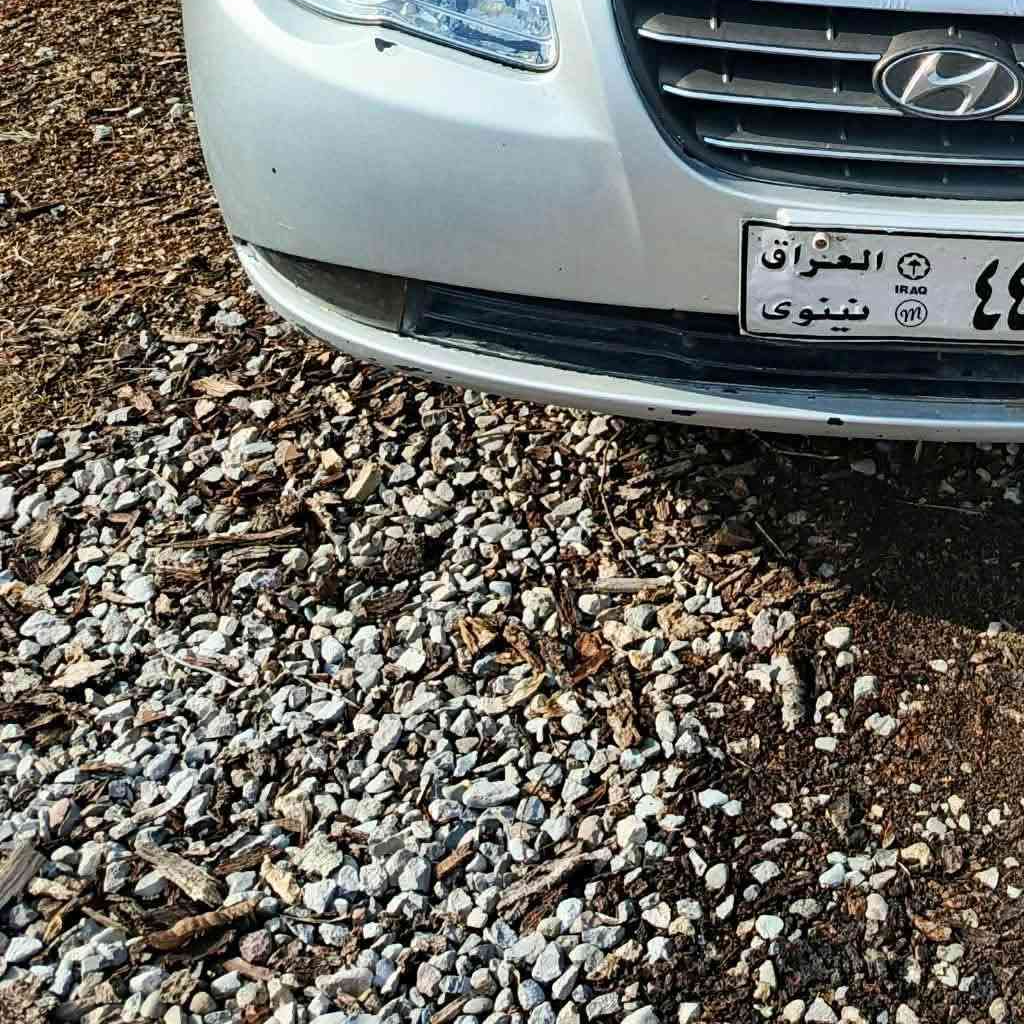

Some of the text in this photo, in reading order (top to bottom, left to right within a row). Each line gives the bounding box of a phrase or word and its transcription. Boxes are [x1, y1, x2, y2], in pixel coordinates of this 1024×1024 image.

[761, 240, 884, 277] العراق
[895, 284, 928, 297] IRAQ
[761, 296, 870, 332] نينوى
